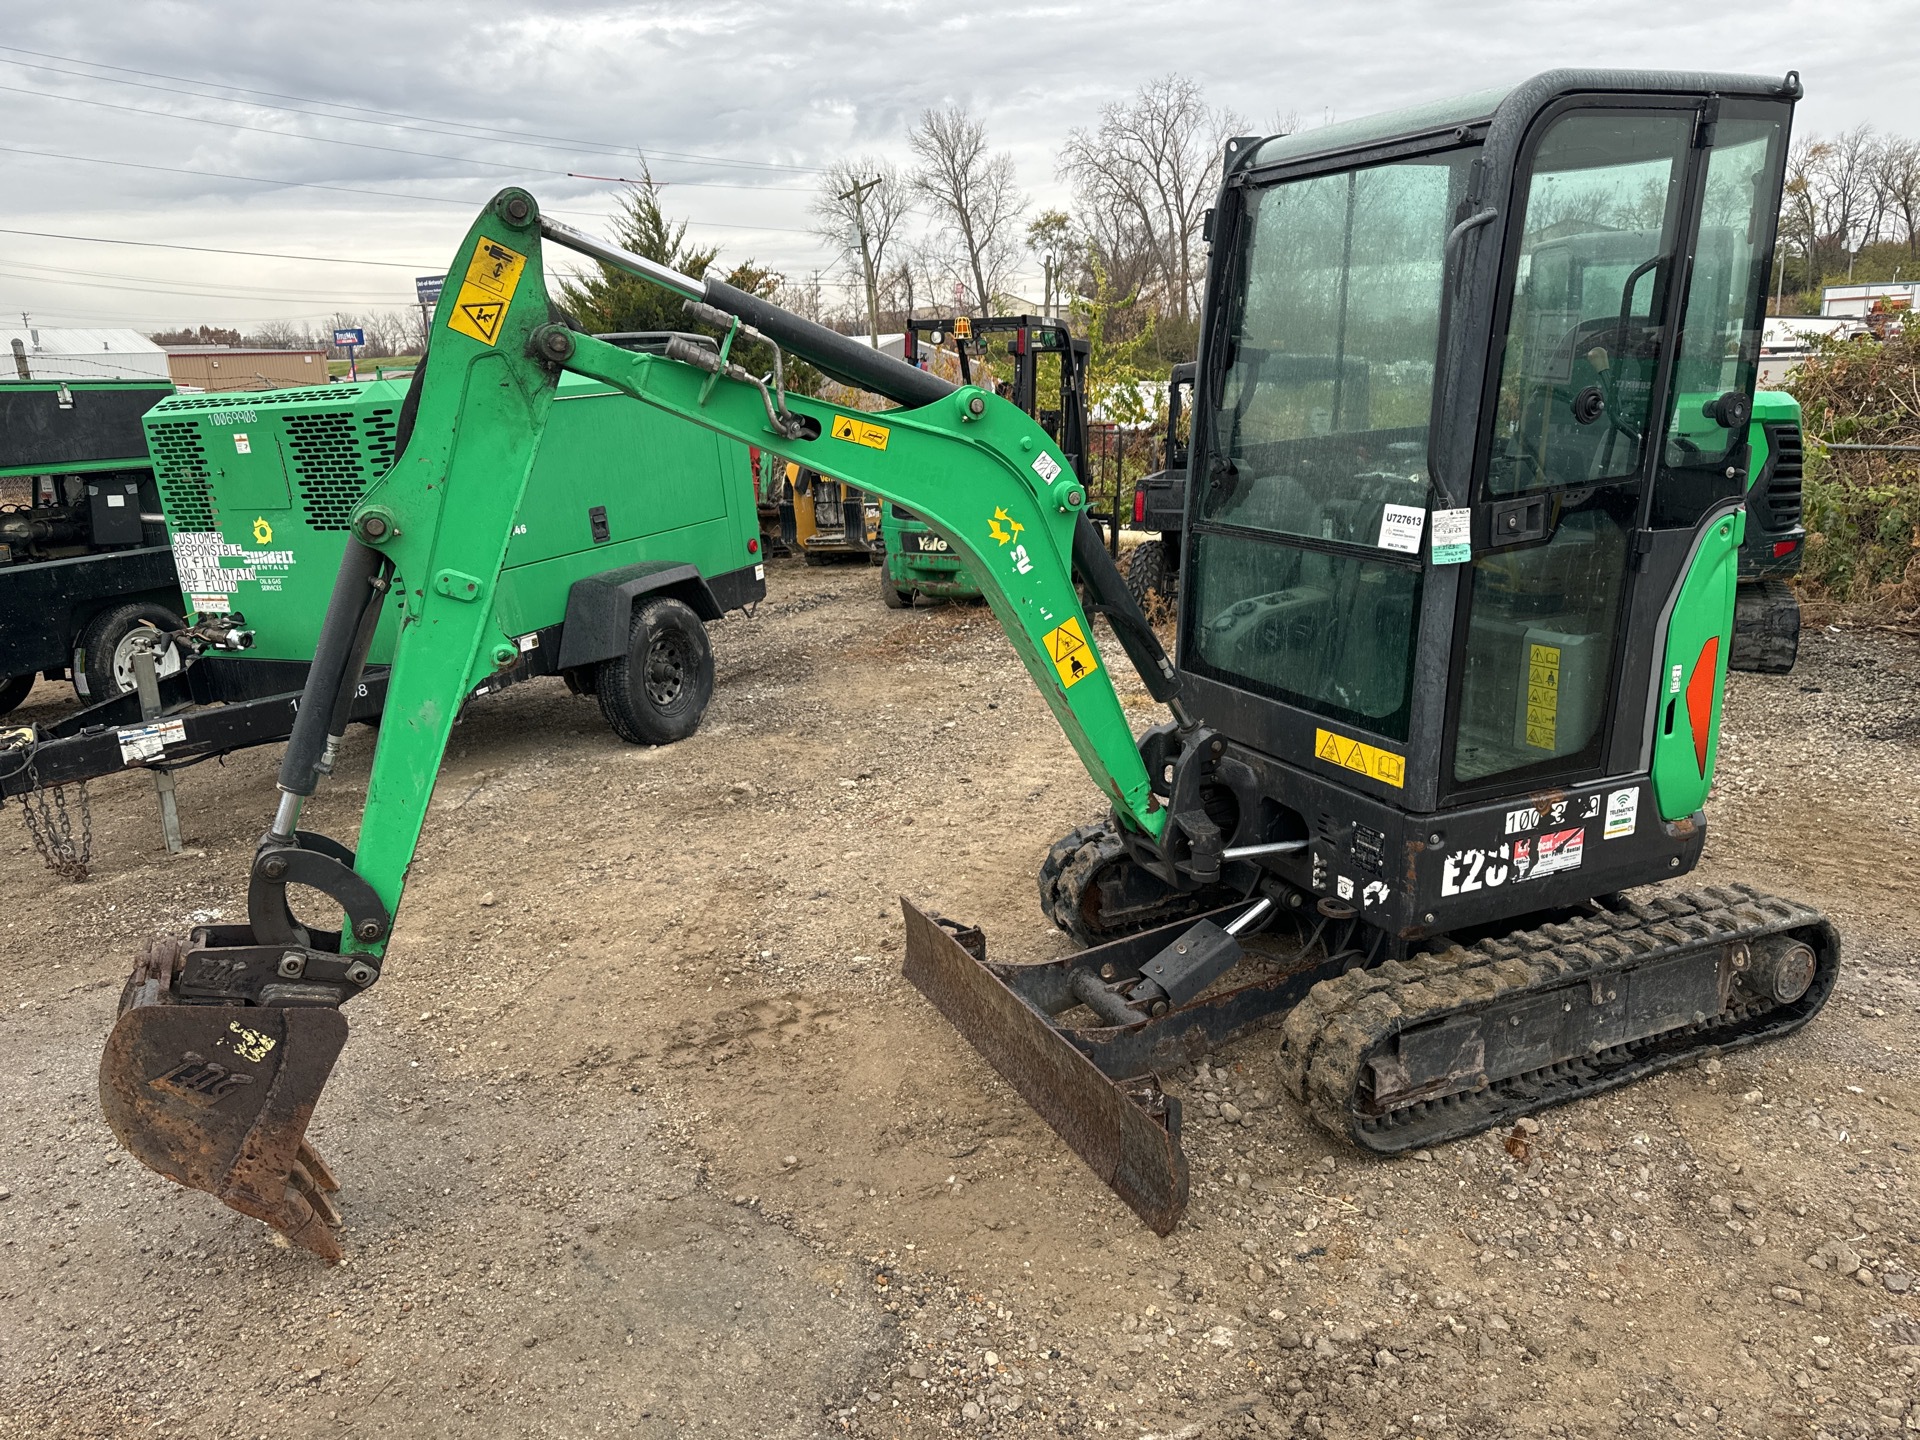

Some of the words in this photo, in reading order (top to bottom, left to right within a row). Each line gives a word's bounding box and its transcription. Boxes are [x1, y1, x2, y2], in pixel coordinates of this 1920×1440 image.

[208, 410, 258, 426] 10069908
[1386, 513, 1422, 526] U727613
[173, 532, 224, 545] CUSTOMER
[918, 537, 948, 551] Yale
[173, 544, 242, 557] RESPONSIBLE
[175, 557, 189, 568] TO
[193, 556, 220, 568] FILL
[180, 569, 198, 580] AND
[204, 568, 256, 580] MAINTAIN
[181, 581, 200, 592] DEF
[205, 580, 237, 592] FLUID
[1610, 806, 1634, 815] TELEMATICS
